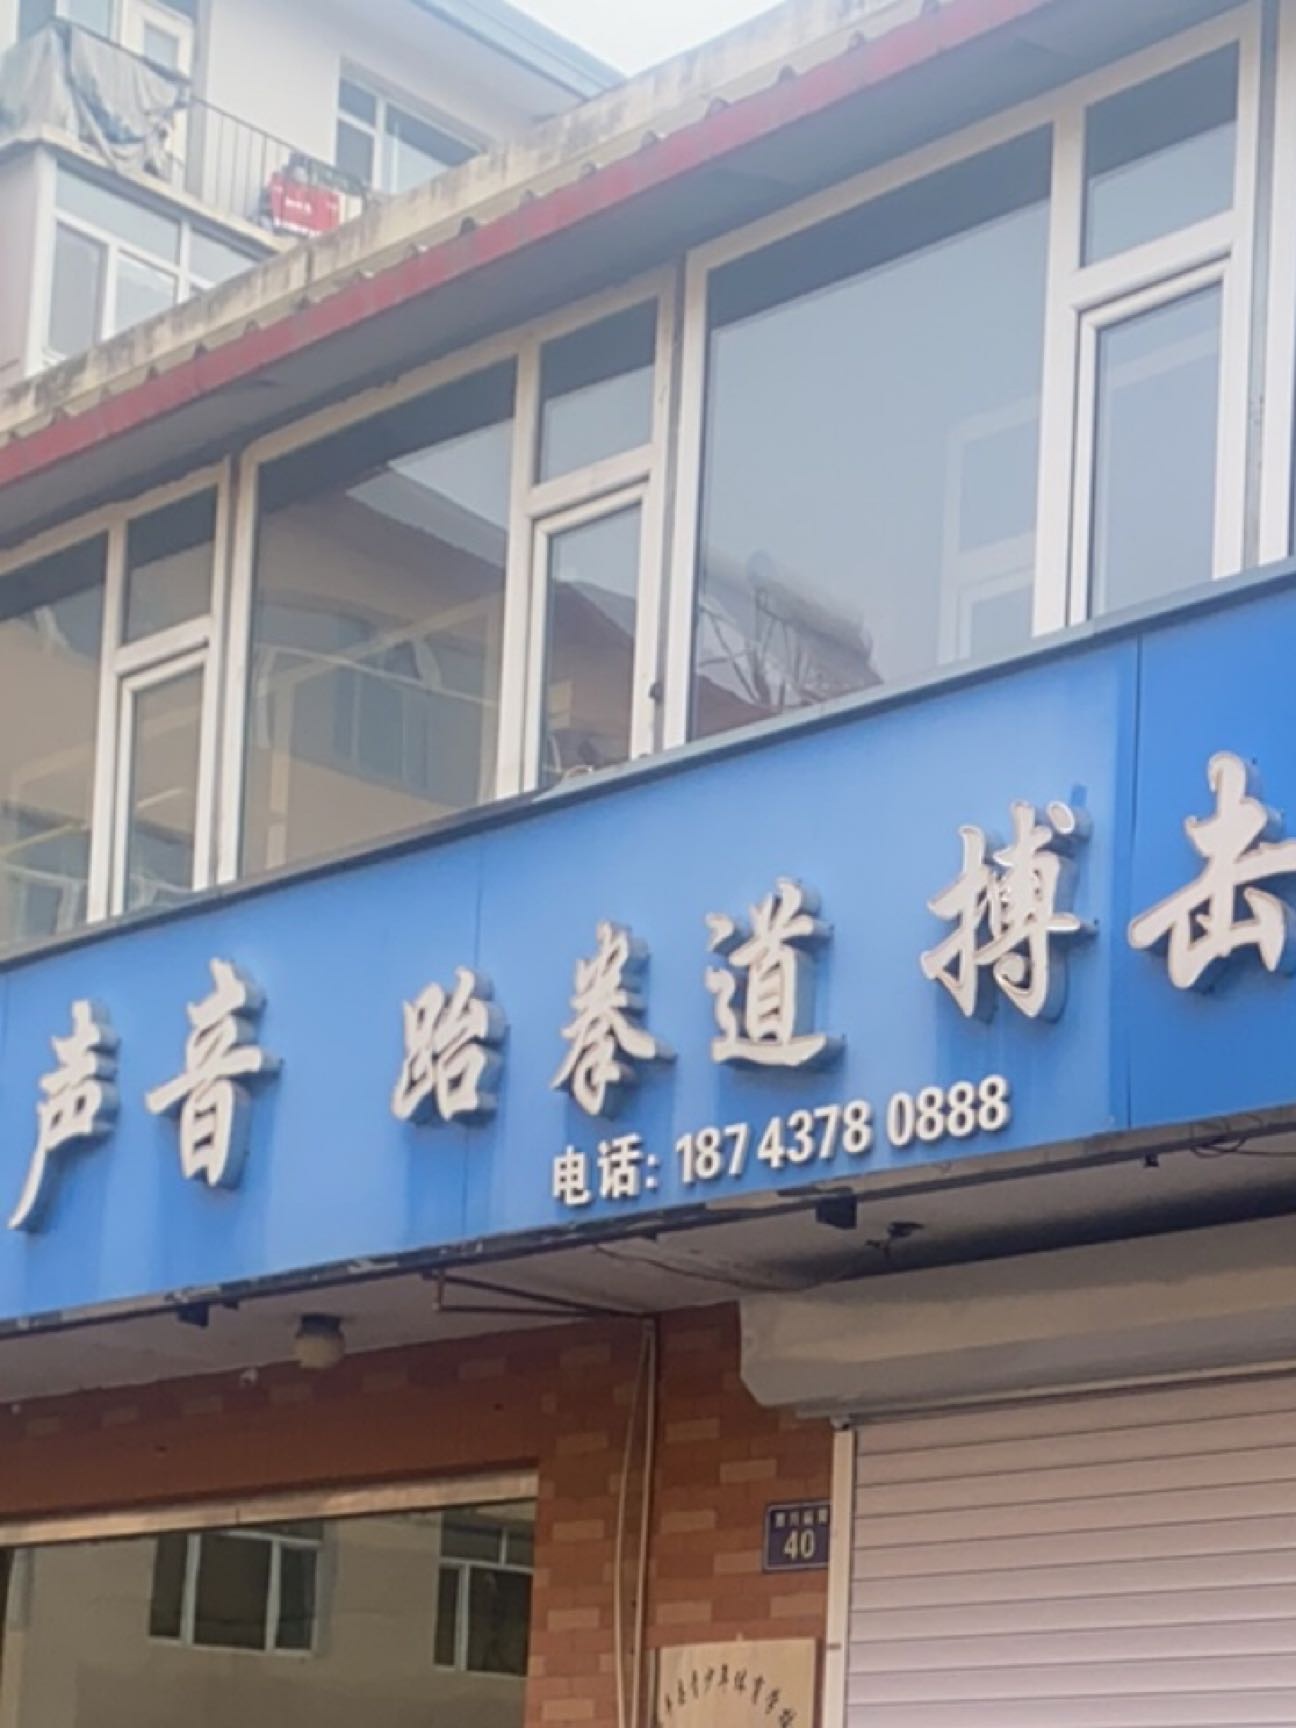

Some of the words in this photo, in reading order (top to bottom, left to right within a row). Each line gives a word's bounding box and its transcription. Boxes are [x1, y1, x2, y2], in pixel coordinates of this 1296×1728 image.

[8, 957, 274, 1230] 声音
[391, 877, 836, 1121] 跆拳道
[886, 1074, 1009, 1148] 0888
[784, 1528, 815, 1560] 40
